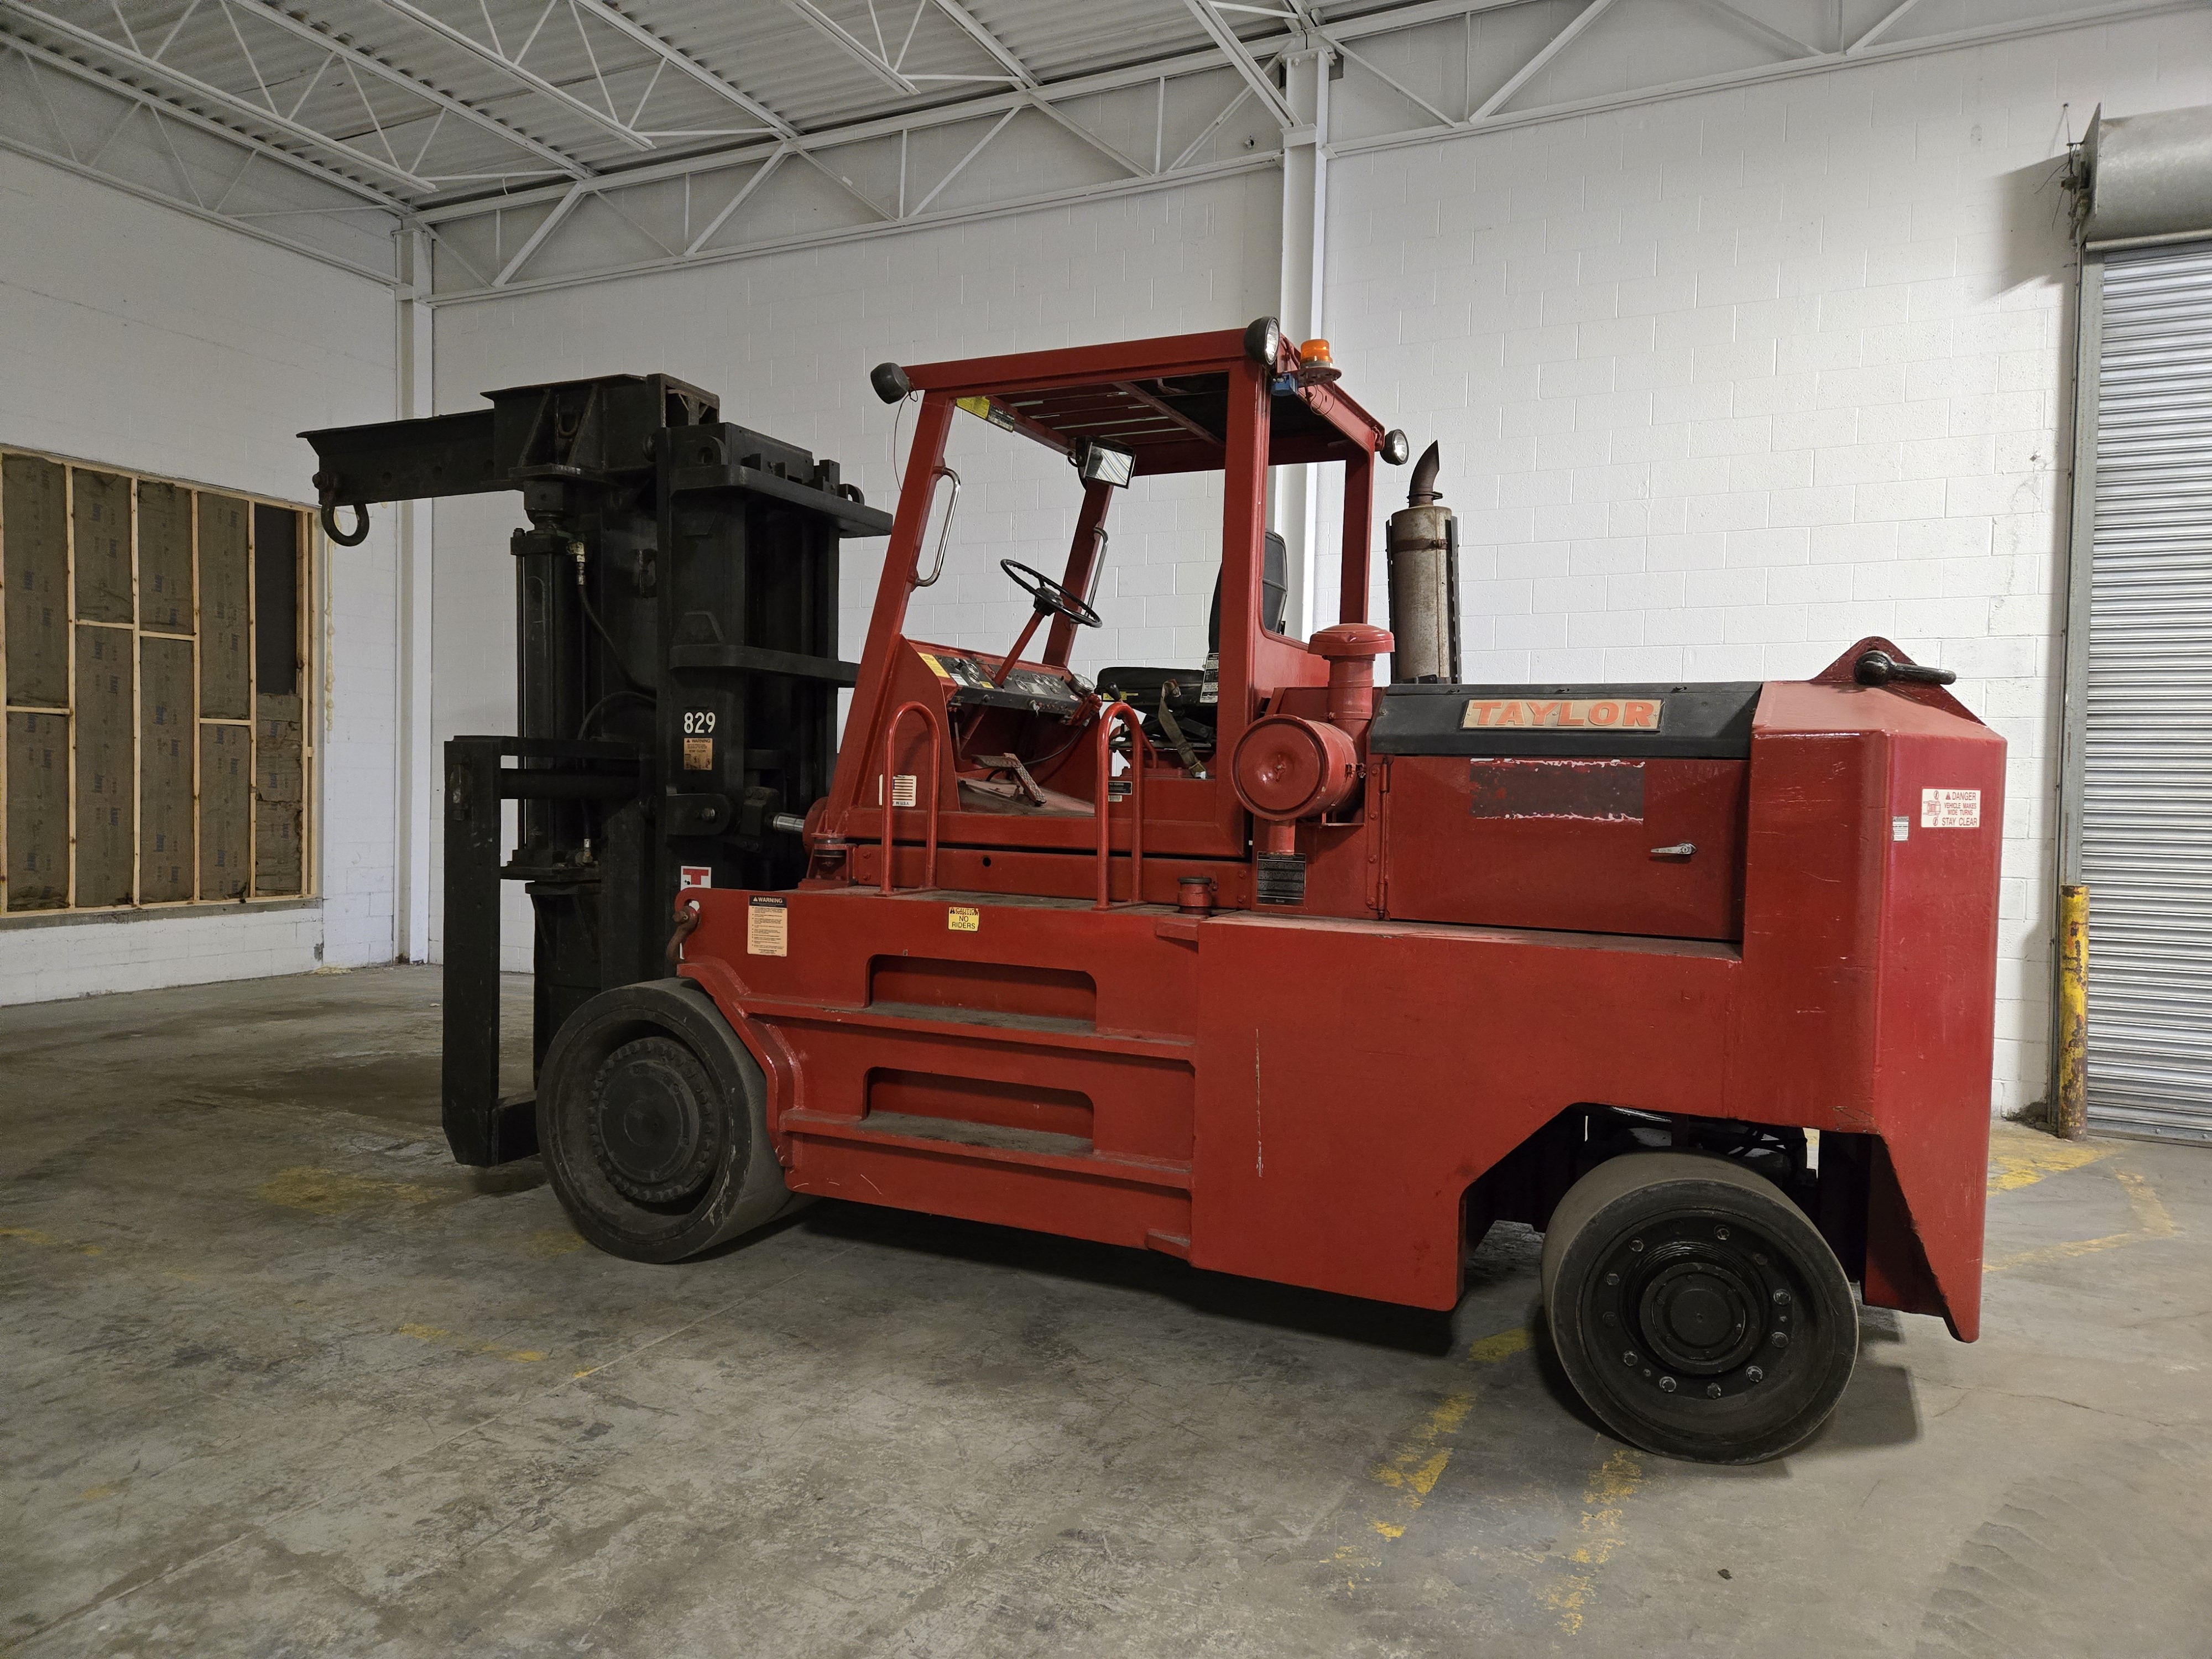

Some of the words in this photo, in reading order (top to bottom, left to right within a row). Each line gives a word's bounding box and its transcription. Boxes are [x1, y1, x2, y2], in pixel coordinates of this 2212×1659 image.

[1472, 701, 1655, 727] TAYLOR
[684, 712, 716, 734] 829
[1952, 792, 1976, 800] DANGER
[1942, 817, 1956, 826] STAY
[1959, 817, 1978, 826] CLEAR
